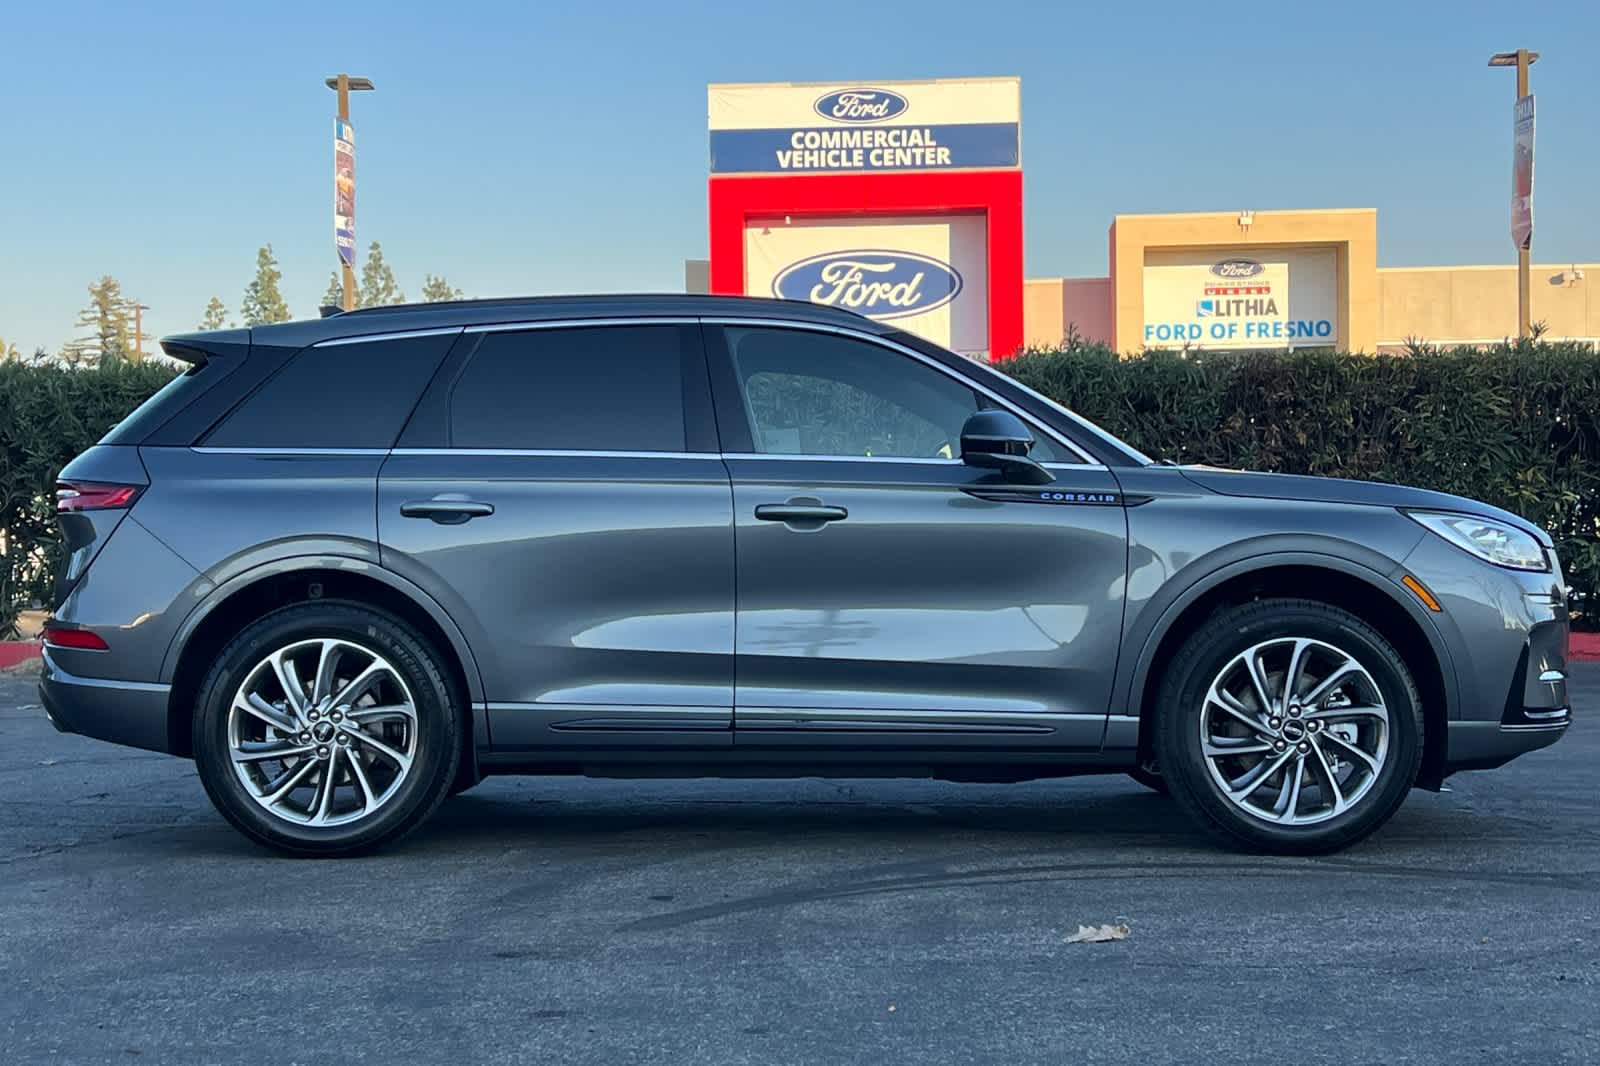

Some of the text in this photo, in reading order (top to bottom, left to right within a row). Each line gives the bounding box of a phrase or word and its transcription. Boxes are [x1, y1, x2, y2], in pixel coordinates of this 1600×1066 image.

[832, 93, 889, 118] Ford
[790, 129, 937, 150] COMMERCIAL
[776, 147, 952, 169] VEHICLE CENTER
[1220, 262, 1254, 276] Ford
[810, 261, 924, 308] Ford
[1215, 298, 1279, 317] LITHIA
[1144, 319, 1332, 341] FORD OF FRESNO
[1040, 492, 1115, 502] CORSAIR
